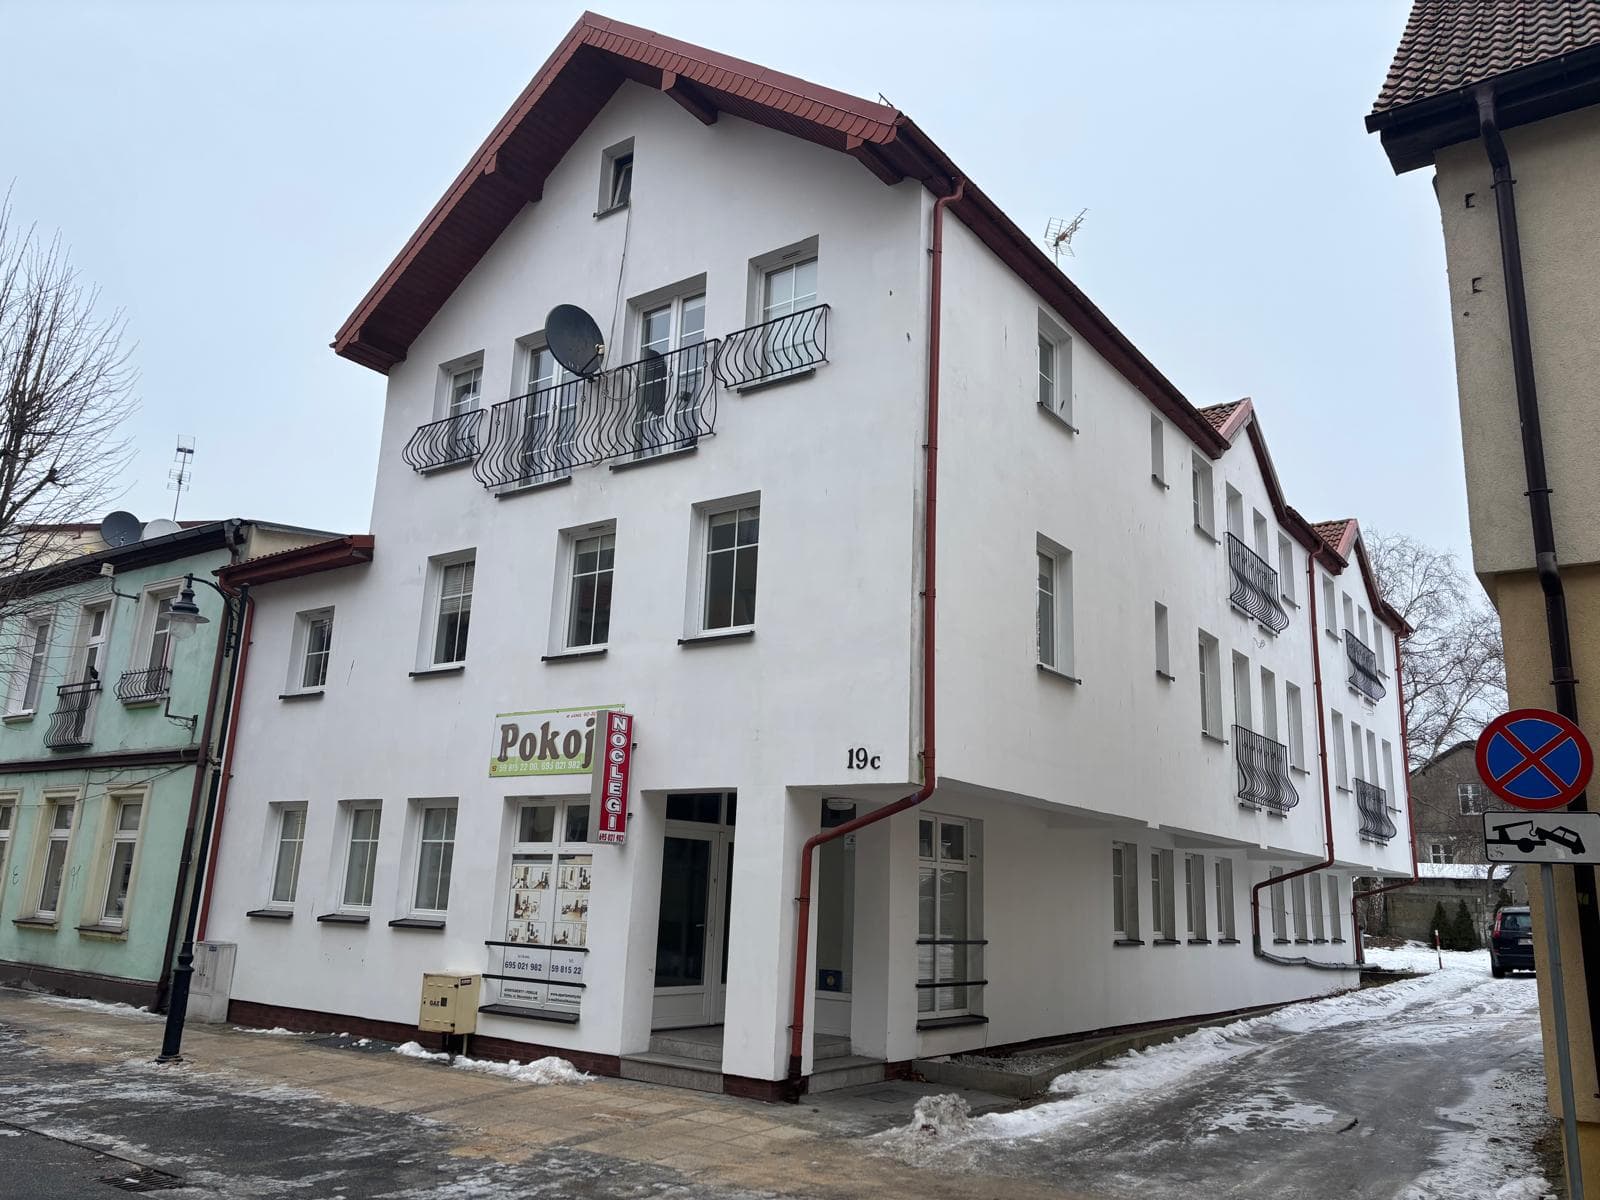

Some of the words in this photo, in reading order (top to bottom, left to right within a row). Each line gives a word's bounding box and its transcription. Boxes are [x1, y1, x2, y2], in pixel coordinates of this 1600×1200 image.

[847, 747, 881, 770] 19c
[605, 714, 627, 831] NOCLEGI
[504, 960, 516, 970] 695
[517, 962, 528, 971] 021
[530, 963, 543, 972] 982
[551, 964, 559, 973] 59
[560, 965, 572, 974] 815
[573, 966, 582, 975] 22
